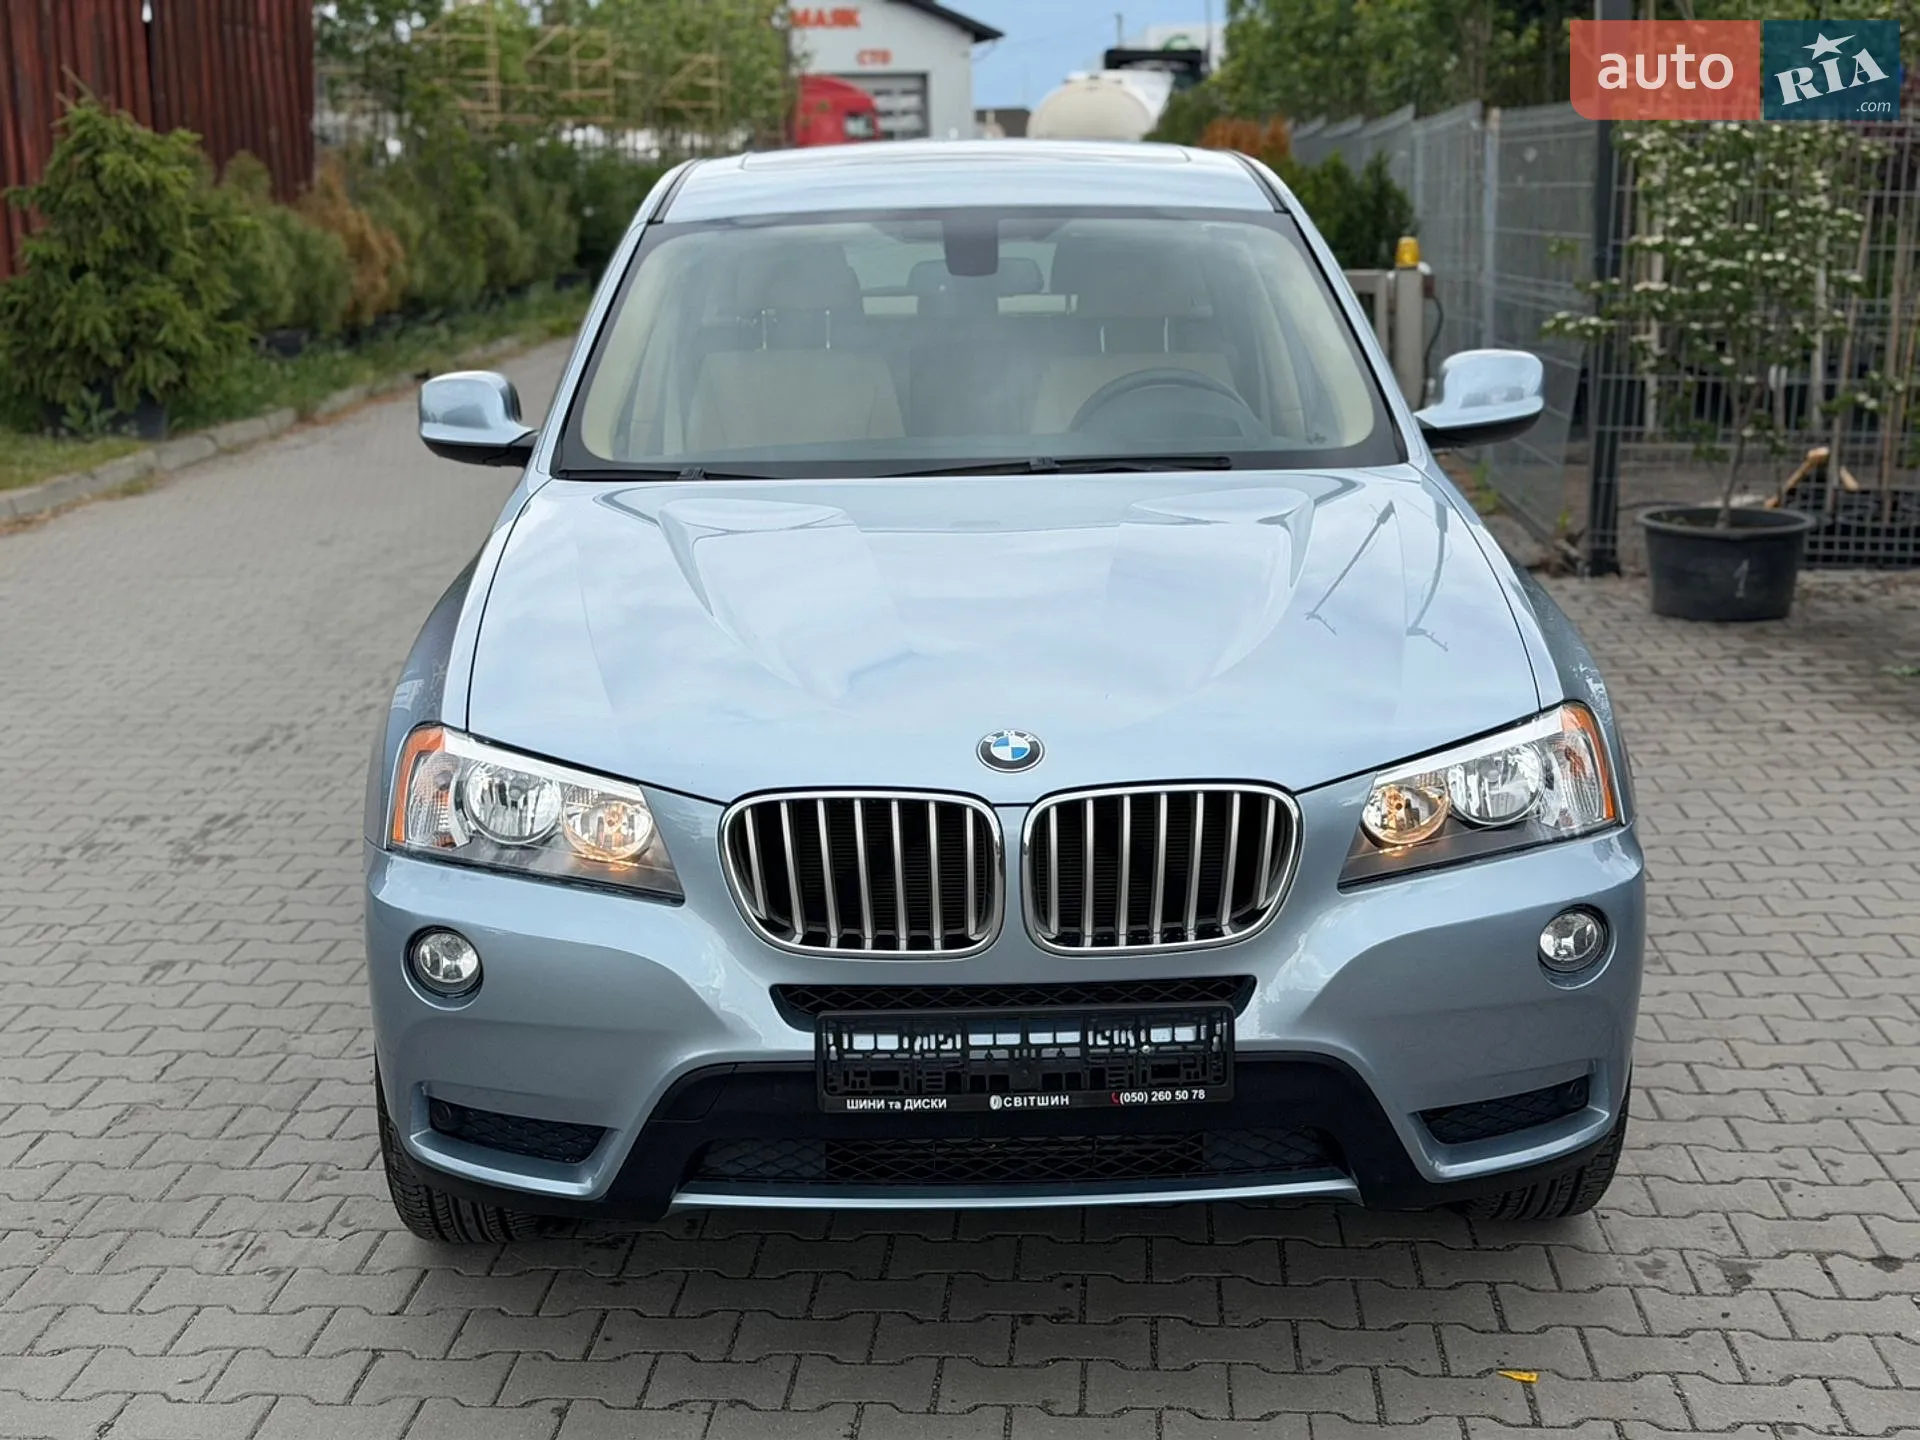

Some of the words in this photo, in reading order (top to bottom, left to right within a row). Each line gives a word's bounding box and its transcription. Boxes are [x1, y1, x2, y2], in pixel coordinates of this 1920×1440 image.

[1003, 1095, 1070, 1107] СВІТШИН
[1119, 1091, 1149, 1104] (050)
[1151, 1091, 1172, 1102] 260
[1175, 1090, 1189, 1101] 50
[1192, 1089, 1206, 1100] 78
[846, 1099, 884, 1109] ШИНИ
[888, 1101, 902, 1109] та
[903, 1098, 947, 1111] ДИСКИ
